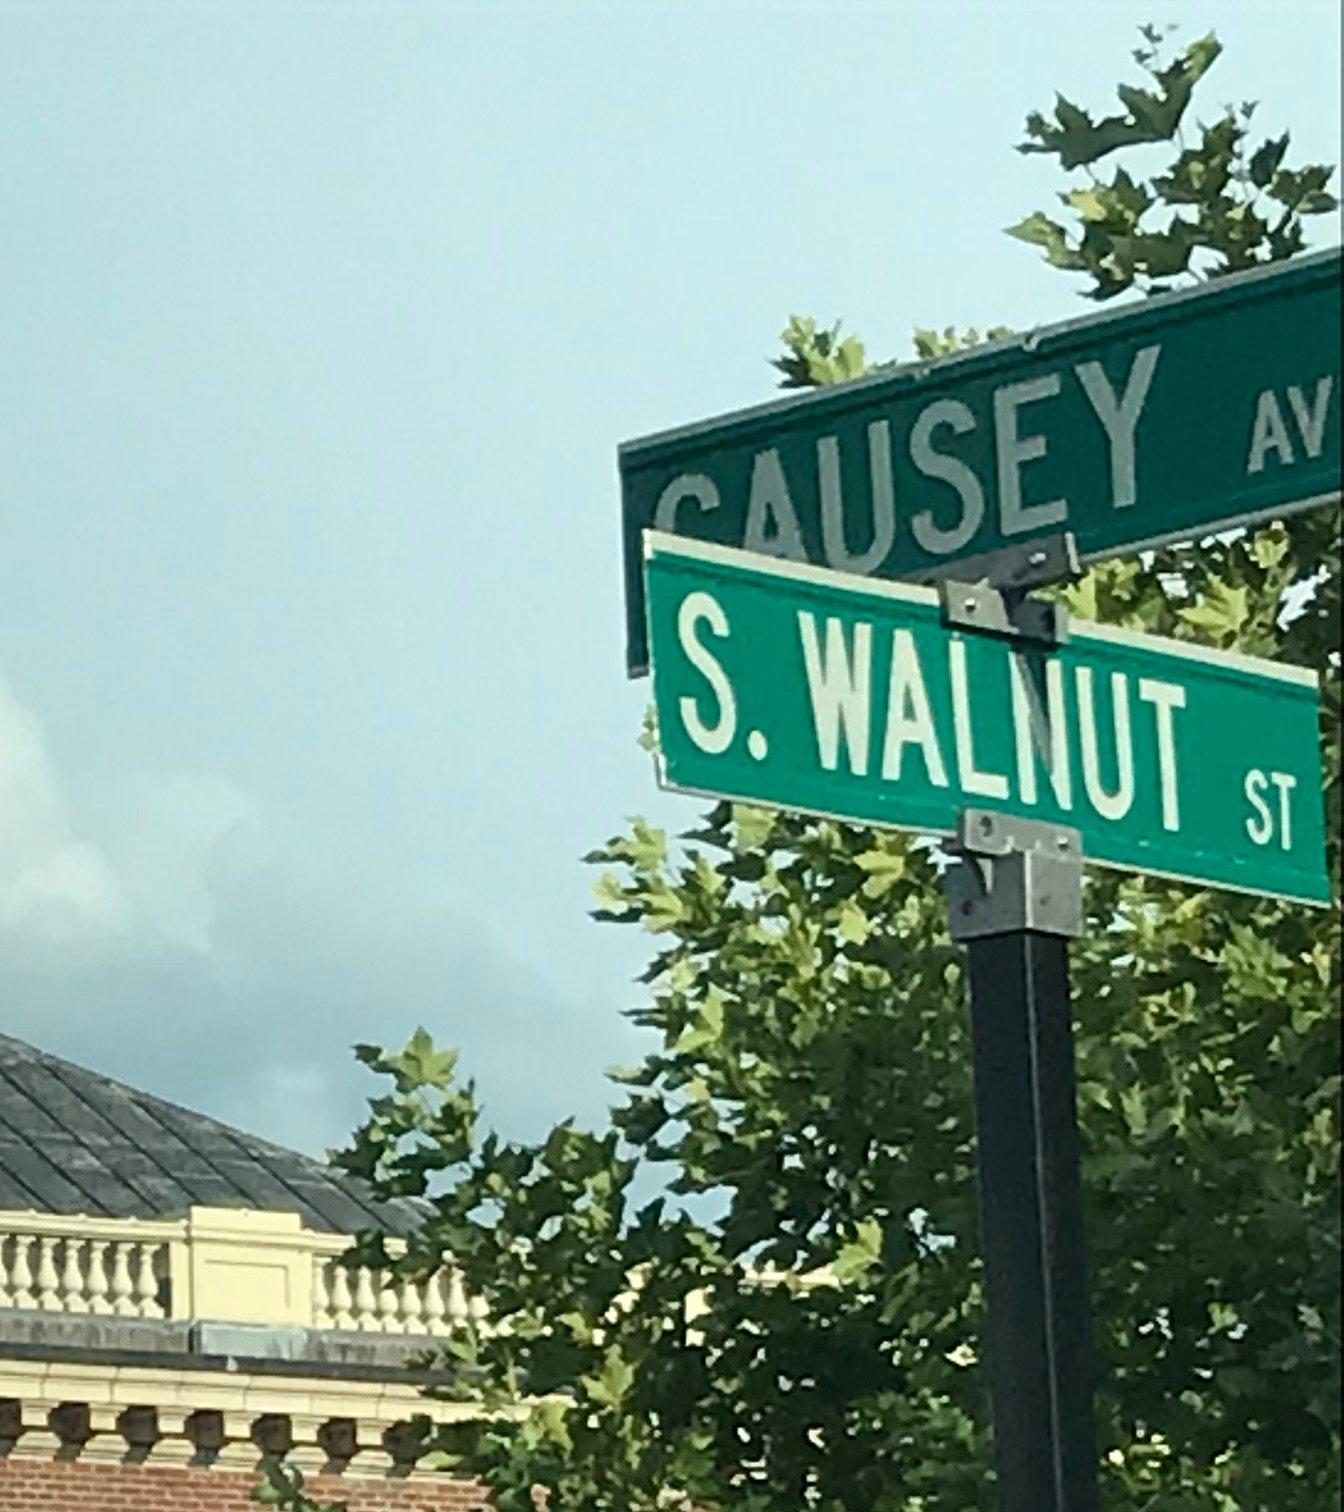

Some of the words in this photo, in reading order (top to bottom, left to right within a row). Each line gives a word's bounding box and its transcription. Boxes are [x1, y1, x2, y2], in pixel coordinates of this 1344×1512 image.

[1246, 374, 1334, 475] AV
[676, 592, 768, 763] S.
[798, 610, 1186, 832] WALNUT
[1244, 768, 1297, 851] ST
